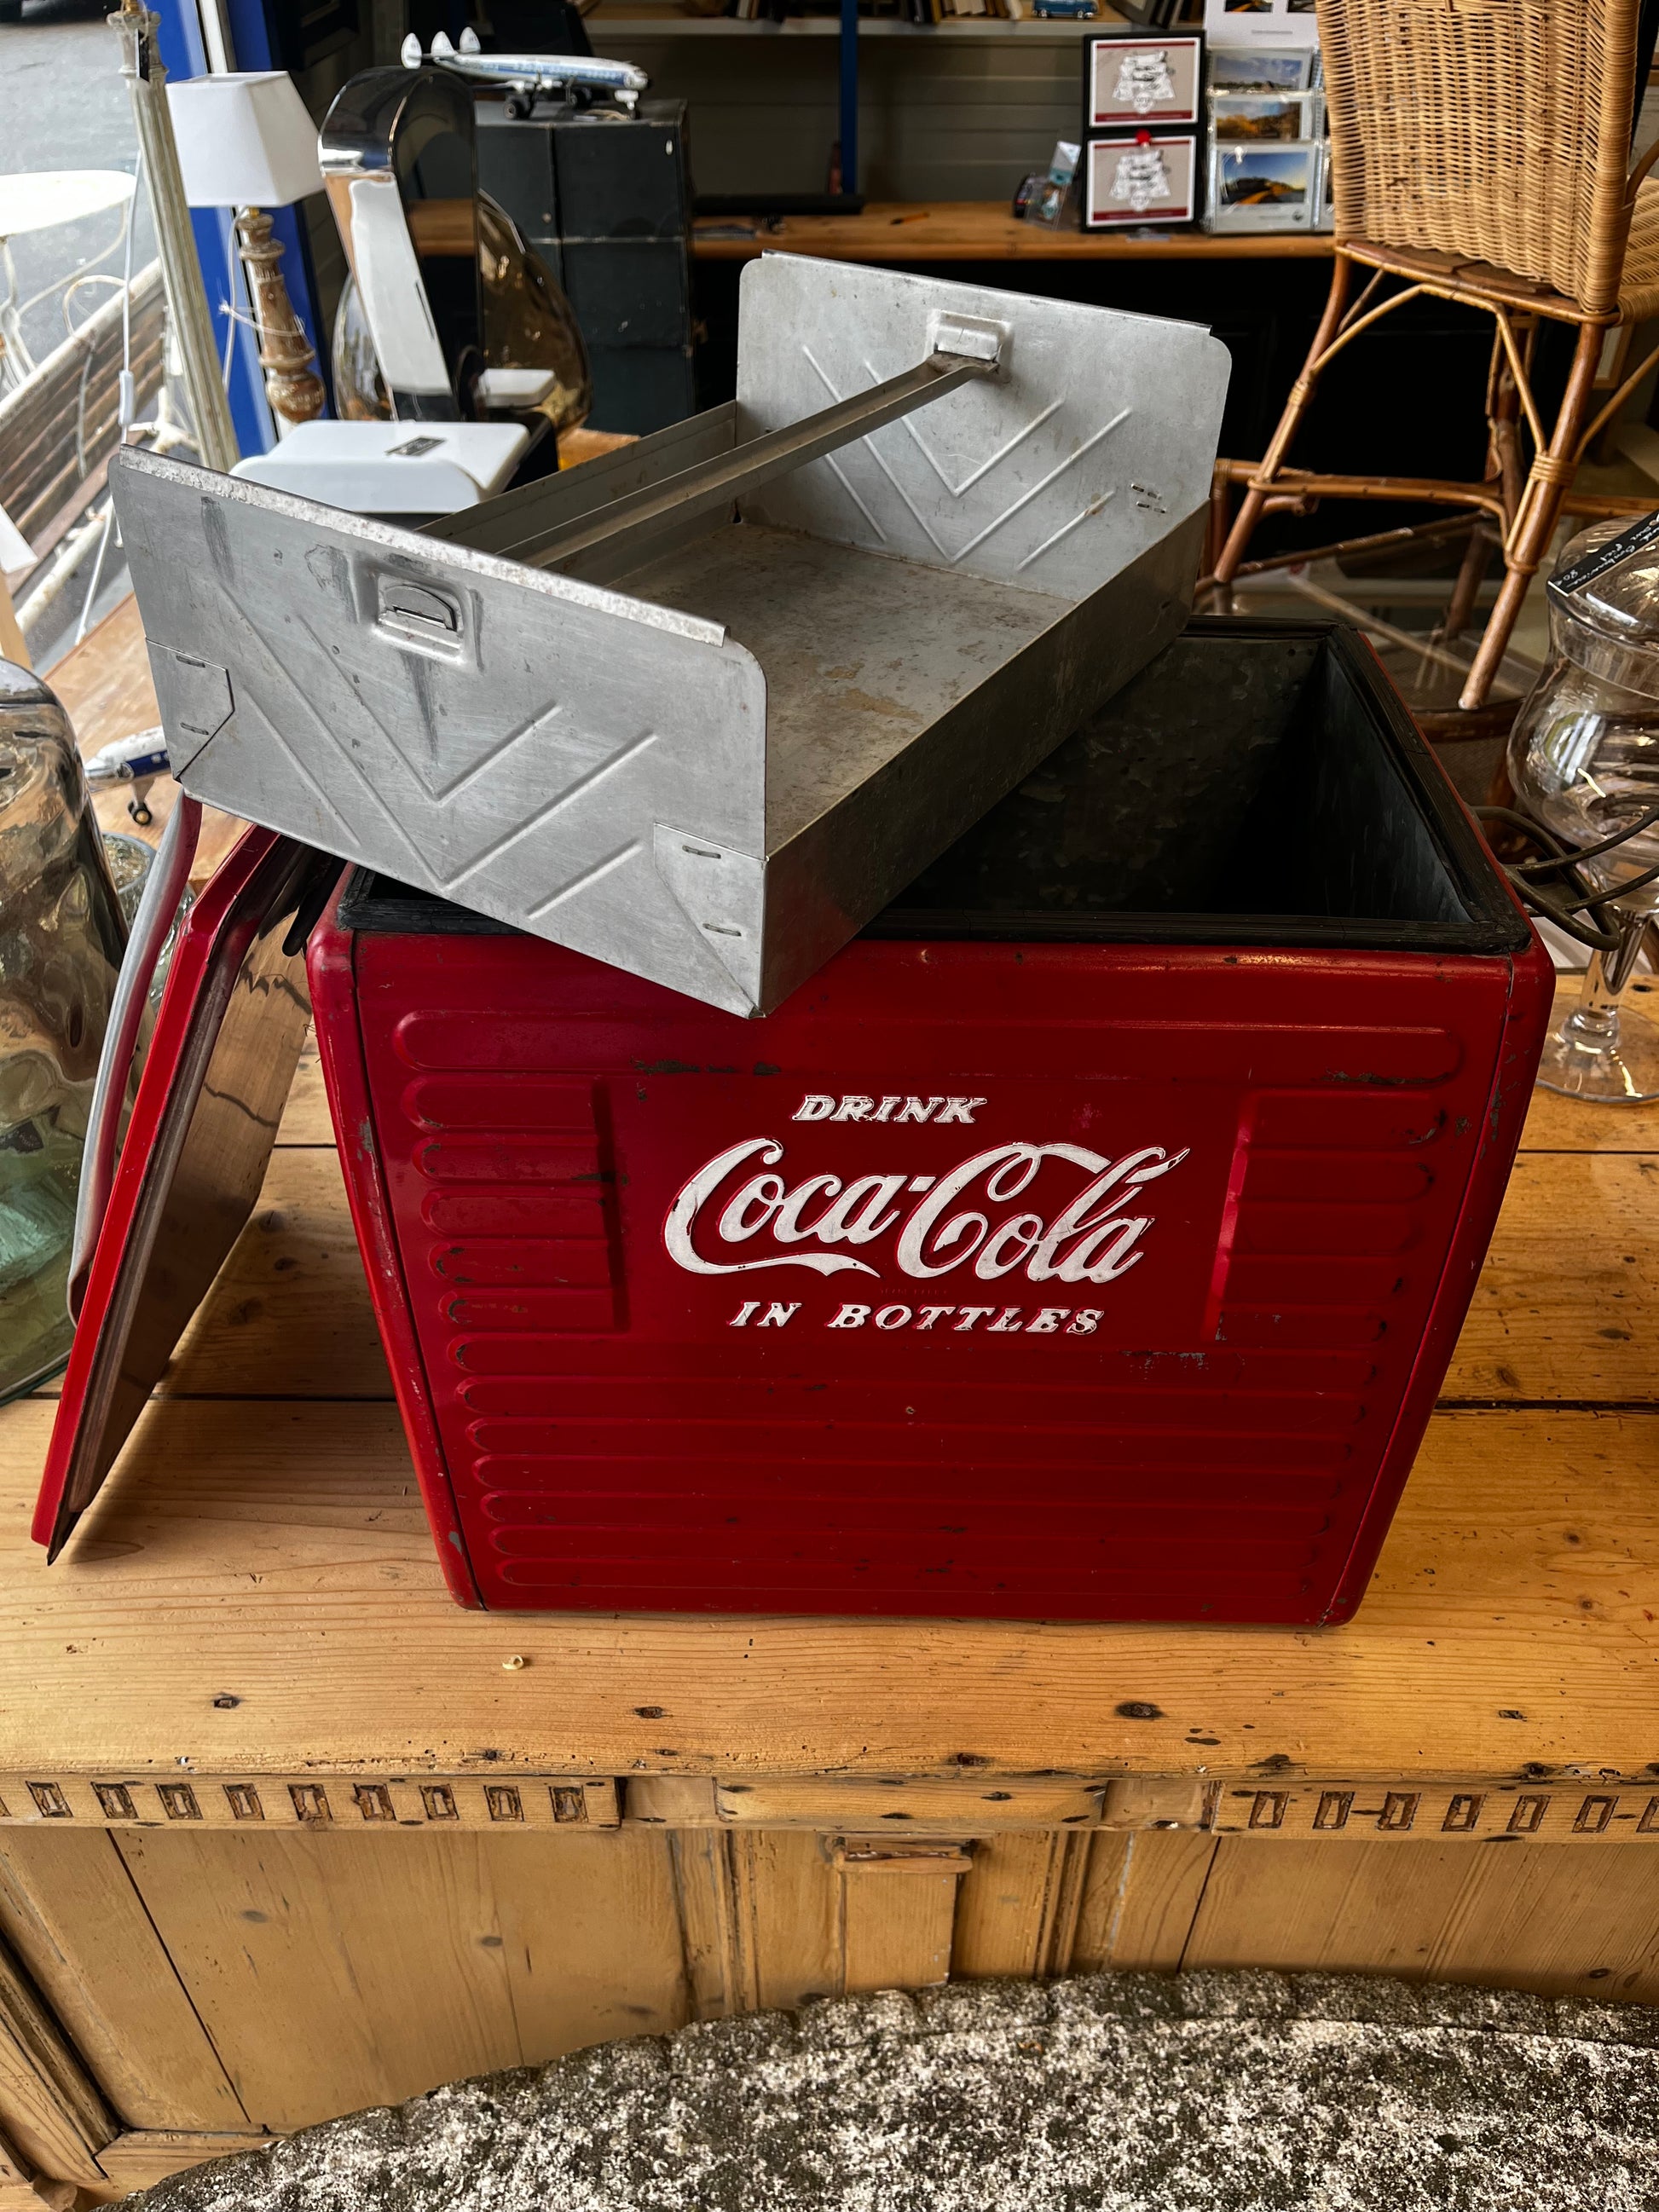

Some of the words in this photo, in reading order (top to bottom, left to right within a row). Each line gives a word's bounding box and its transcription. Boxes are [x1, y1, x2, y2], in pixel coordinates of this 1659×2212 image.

[792, 1095, 987, 1123] DRINK
[665, 1138, 1190, 1283] Coca-Cola
[730, 1302, 801, 1326] IN
[827, 1304, 1104, 1335] BOTTLES
